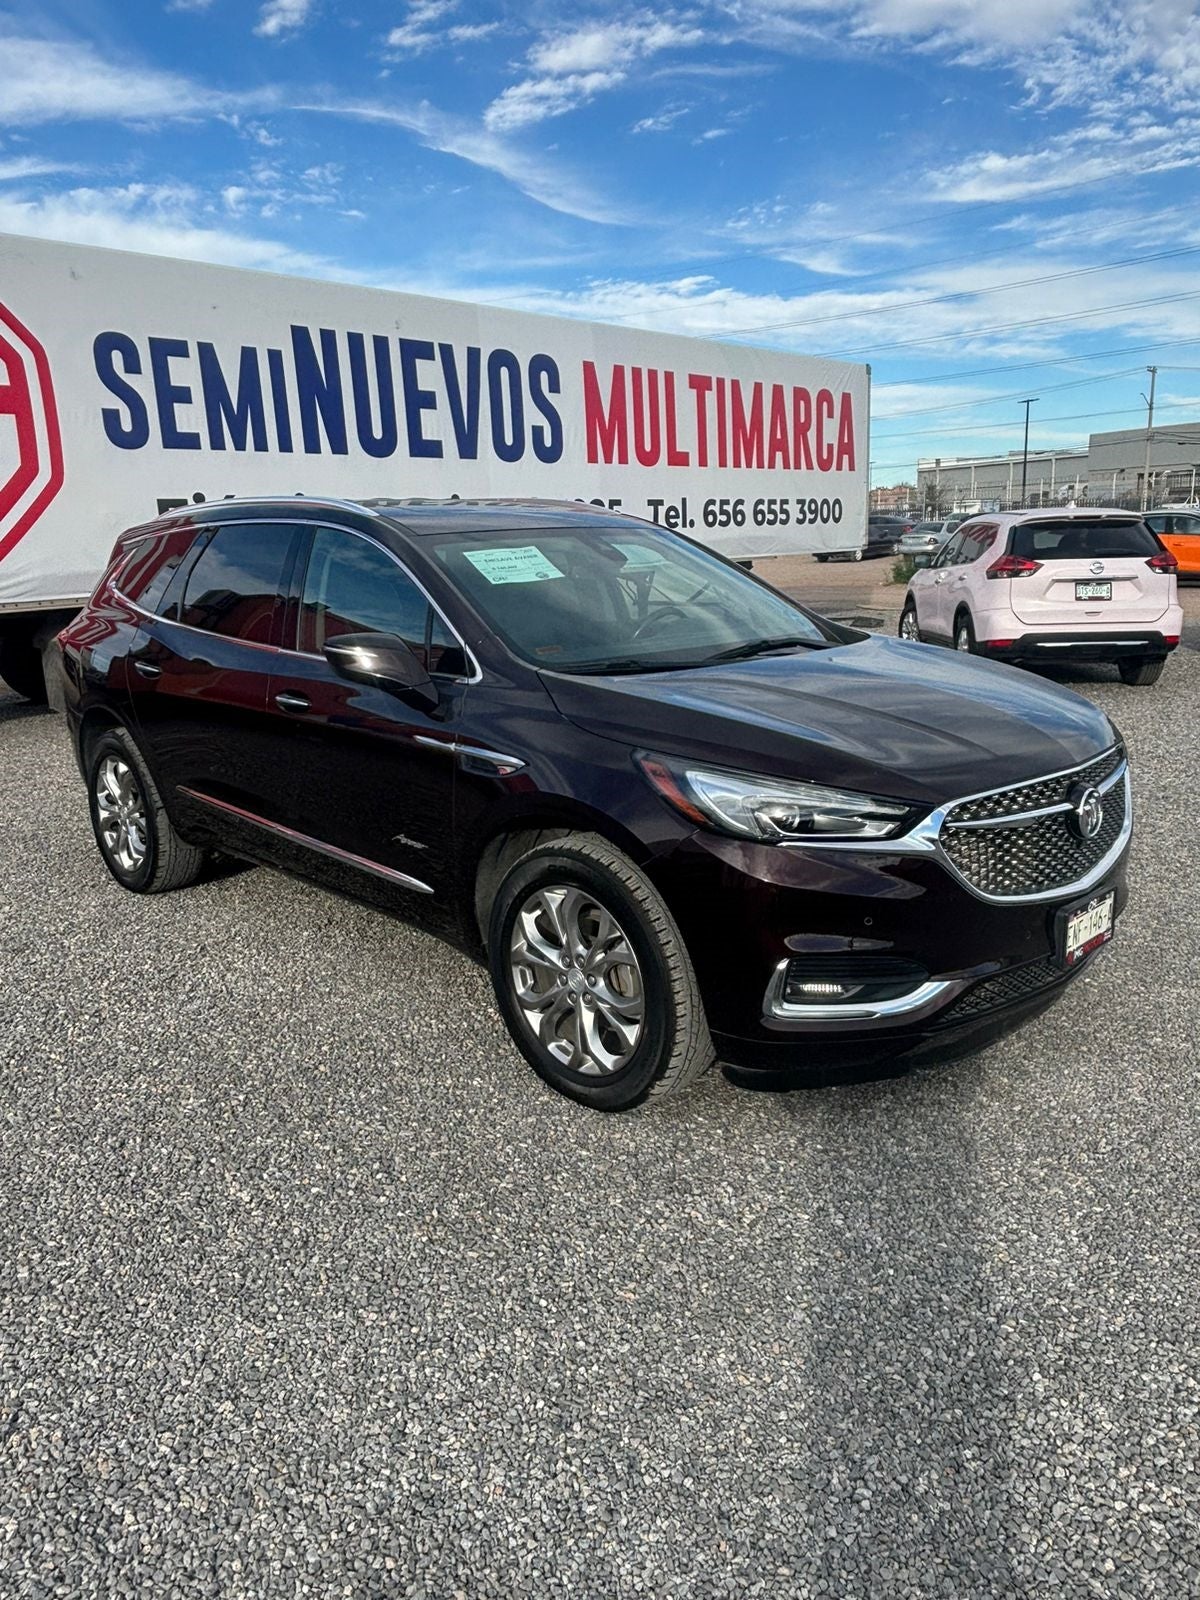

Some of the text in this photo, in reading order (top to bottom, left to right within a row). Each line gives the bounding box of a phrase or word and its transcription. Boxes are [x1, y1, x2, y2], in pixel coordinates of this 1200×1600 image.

[93, 325, 855, 472] SEMINUEVOS MULTIMARCA
[647, 498, 695, 529] Tel.
[702, 498, 746, 528] 656
[753, 498, 790, 526] 655
[796, 498, 843, 525] 3900
